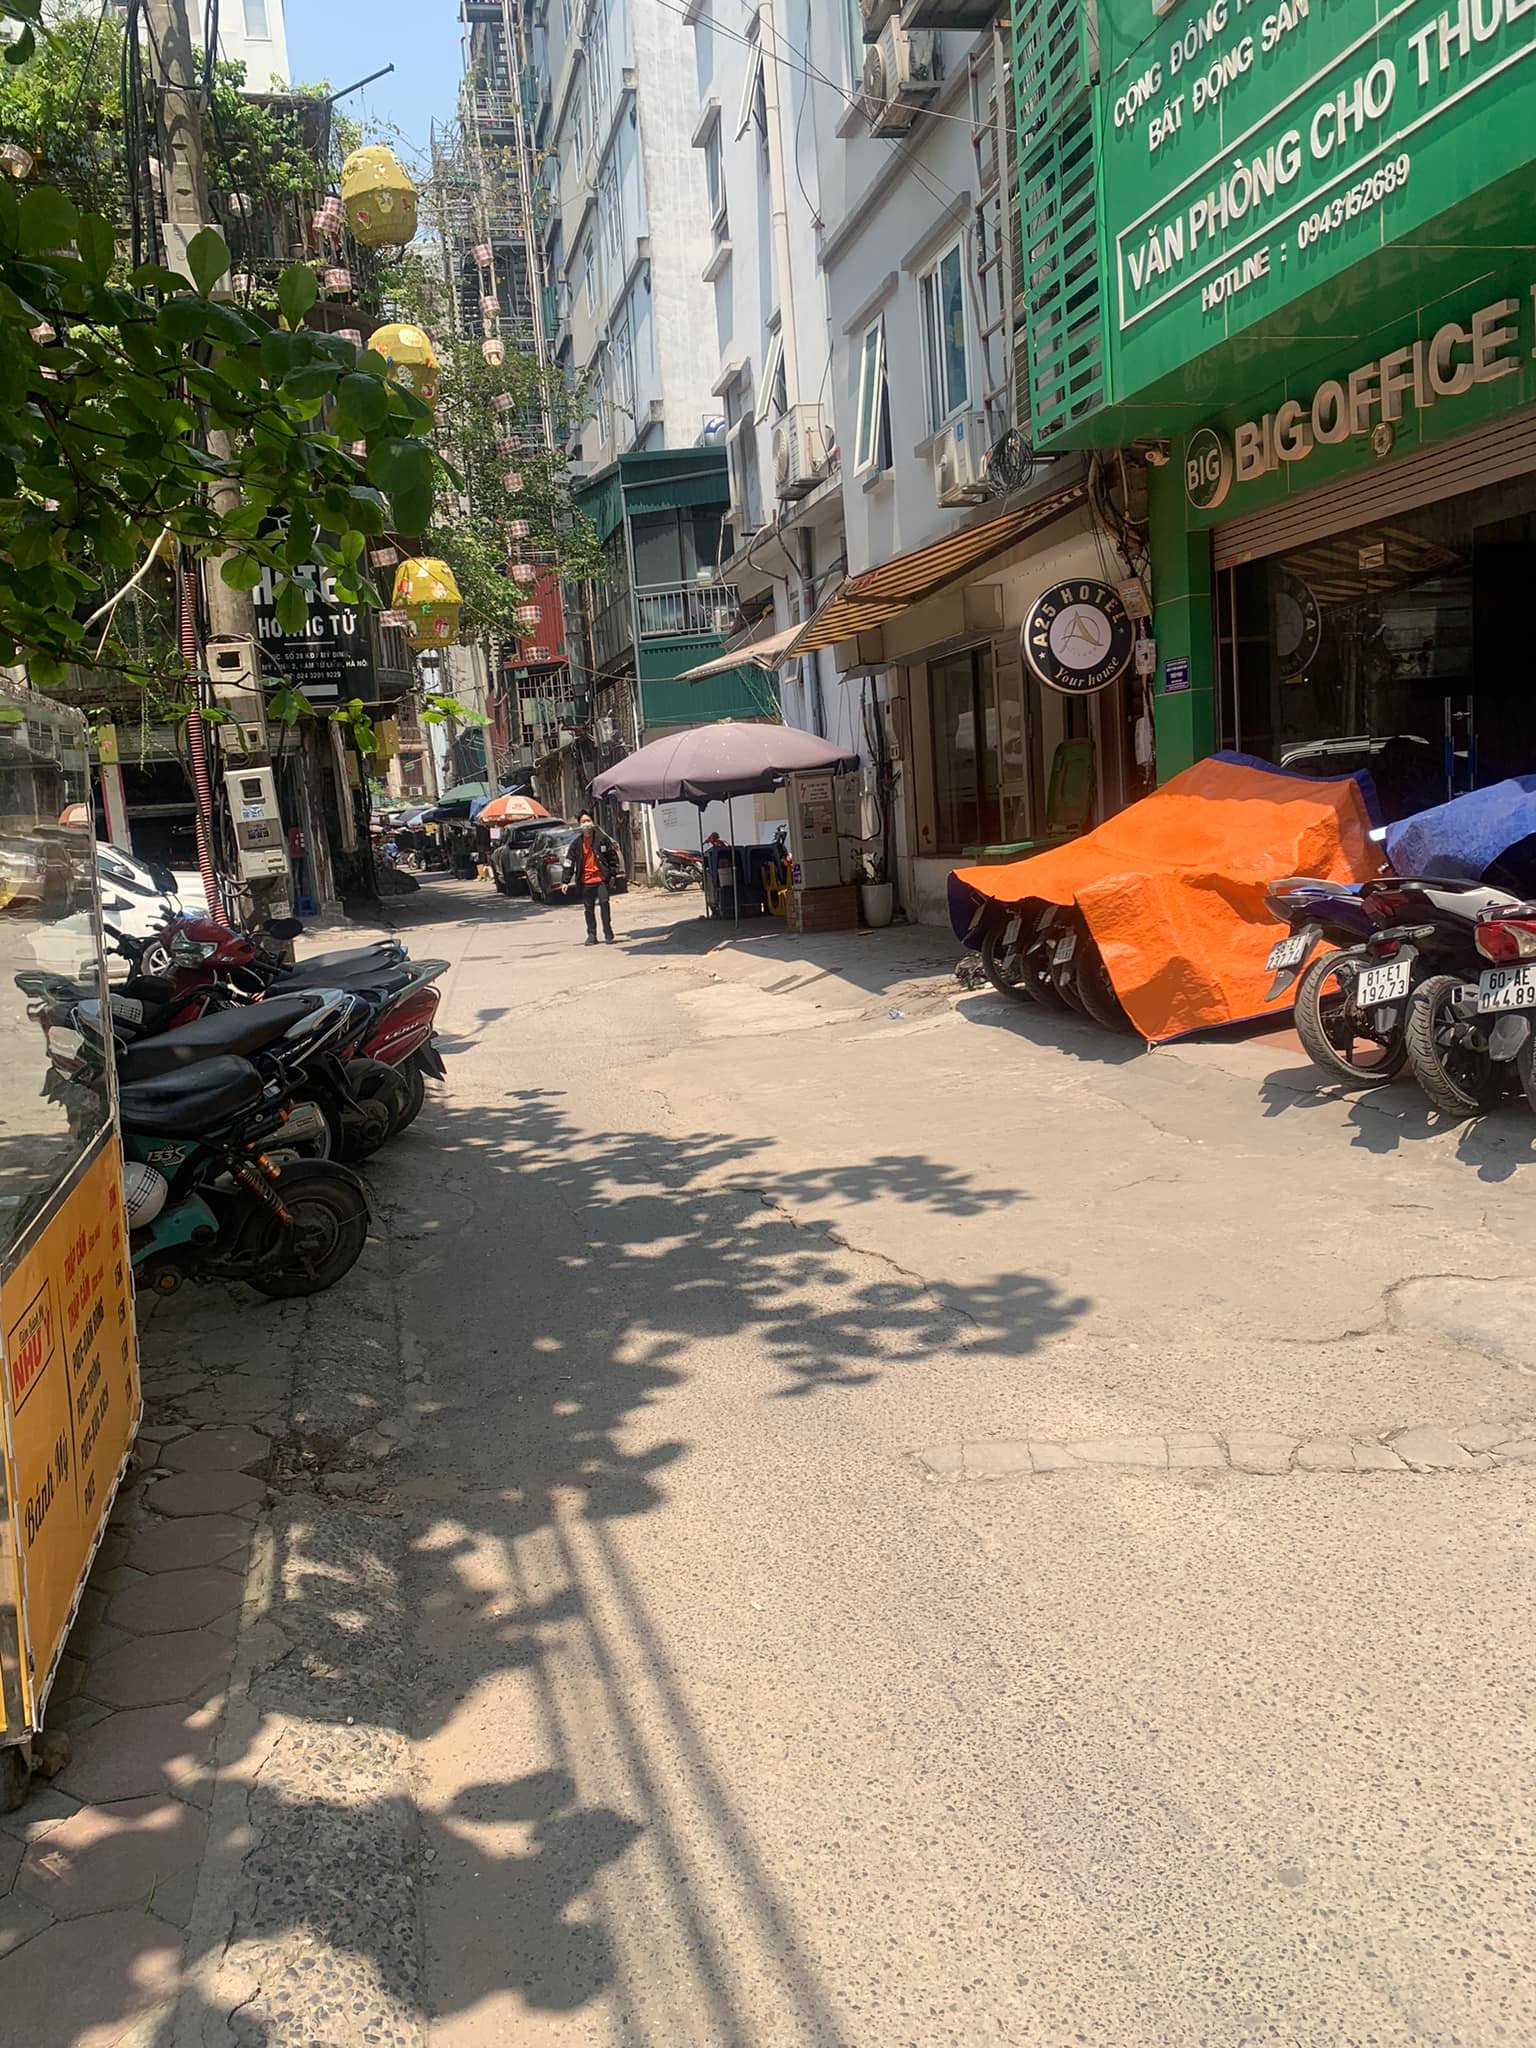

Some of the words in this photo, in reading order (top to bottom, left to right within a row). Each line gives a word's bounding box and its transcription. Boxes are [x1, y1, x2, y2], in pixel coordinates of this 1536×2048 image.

[1113, 61, 1162, 127] CỘNG
[1170, 1, 1228, 76] ĐỒNG
[1149, 94, 1185, 151] BẤT
[1193, 36, 1253, 112] ĐỘNG
[1128, 216, 1184, 291] VĂN
[1189, 130, 1301, 251] PHÒNG
[1310, 58, 1396, 159] CHO
[1201, 246, 1271, 312] HOTLINE
[1297, 153, 1411, 249] 0943152689
[1187, 449, 1220, 490] BIG
[329, 608, 357, 636] TỬ
[1033, 603, 1057, 648] A25
[1060, 584, 1126, 624] HOTEL
[1053, 667, 1085, 688] Your
[1087, 656, 1121, 687] house
[1361, 980, 1405, 1004] 192.73
[1366, 965, 1400, 987] 81-E1
[1489, 967, 1531, 990] 60-AE
[1482, 986, 1535, 1010] 044.89
[25, 1463, 54, 1549] Bánh
